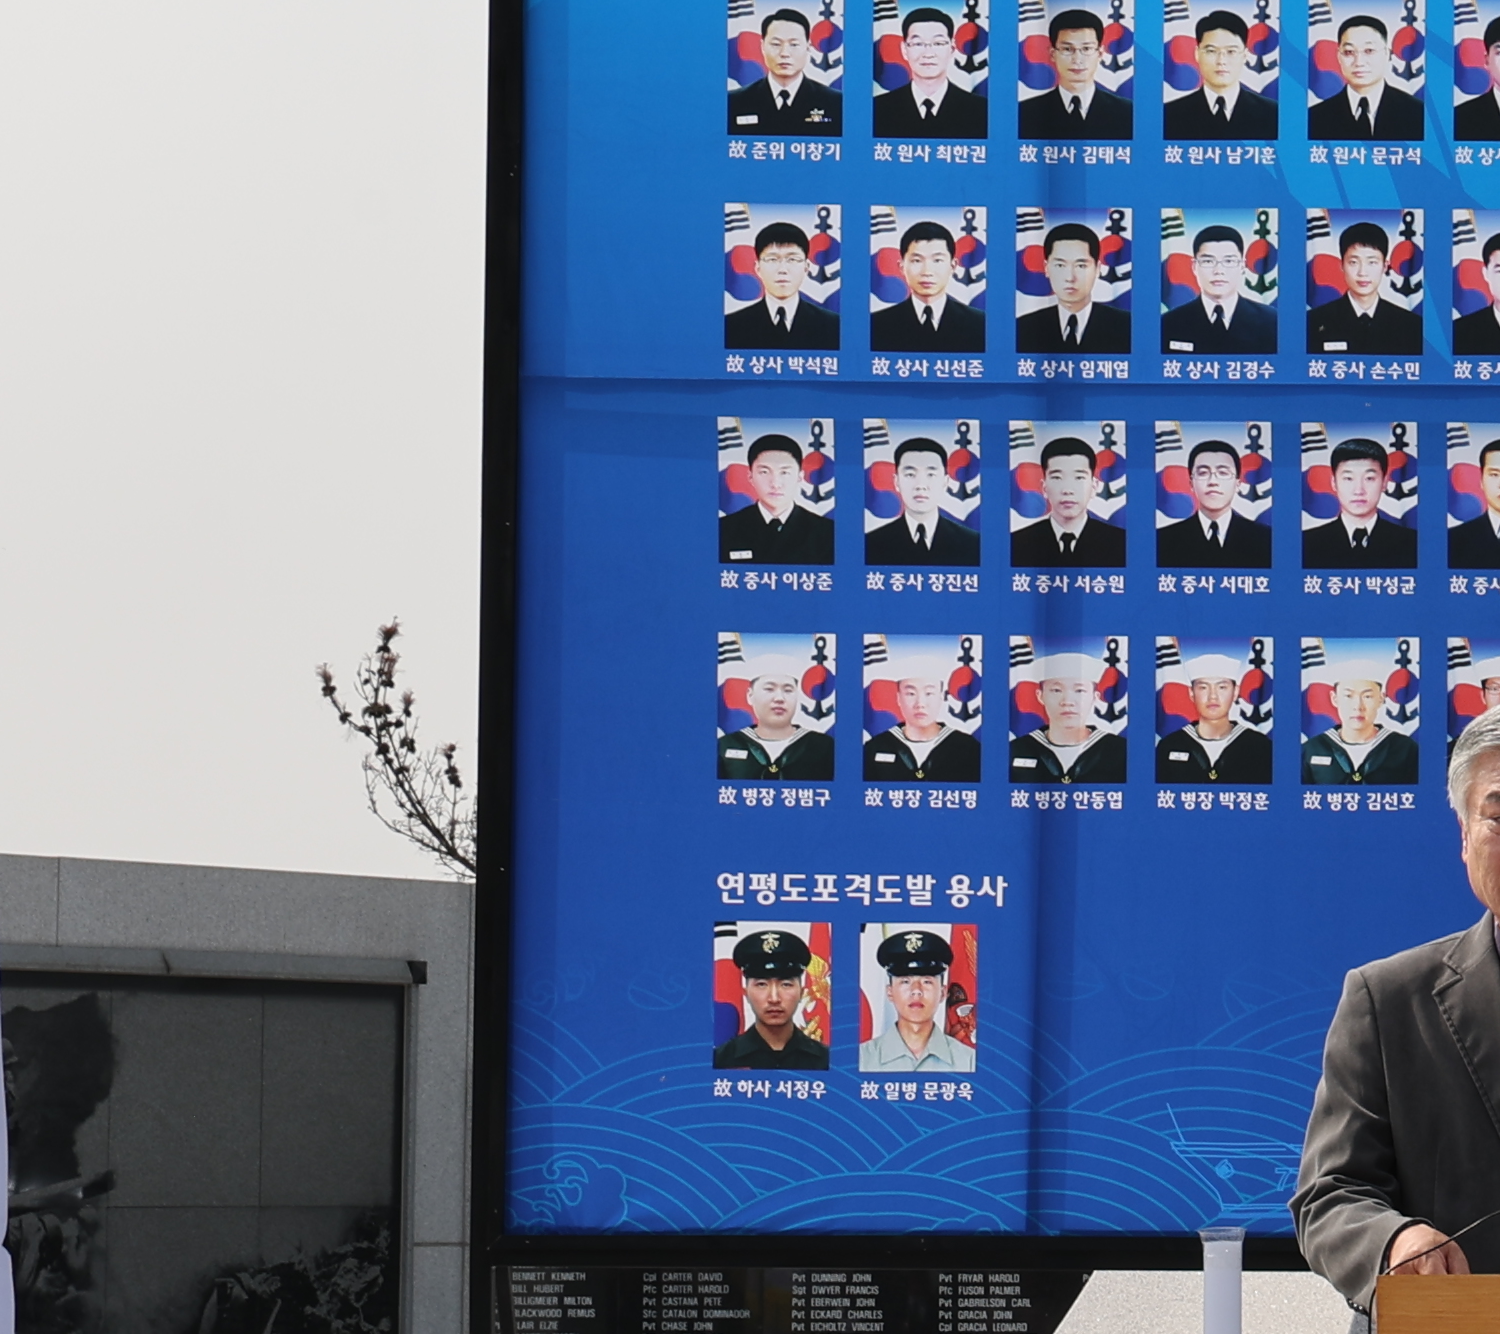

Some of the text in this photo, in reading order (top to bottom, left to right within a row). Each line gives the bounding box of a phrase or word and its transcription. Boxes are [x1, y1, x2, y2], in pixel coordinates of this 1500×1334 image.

[728, 140, 841, 162] 故 준위 이창기
[1019, 143, 1131, 165] 故 원사 김태석
[1309, 144, 1422, 166] 故 원사 문규석
[1454, 145, 1474, 165] 故
[871, 356, 985, 378] 故 상사 신선준
[866, 571, 979, 593] 故 중사 장진선
[1157, 573, 1271, 595] 故 중사 서대호
[1449, 574, 1469, 594] 故
[1156, 789, 1270, 811] 故 병장 박정훈
[1302, 790, 1416, 812] 故 병장 김선호
[716, 872, 1009, 909] 연평도포격도발 용사
[713, 1078, 827, 1100] 故 하사 서정우
[860, 1080, 974, 1102] 故 일병 문광욱
